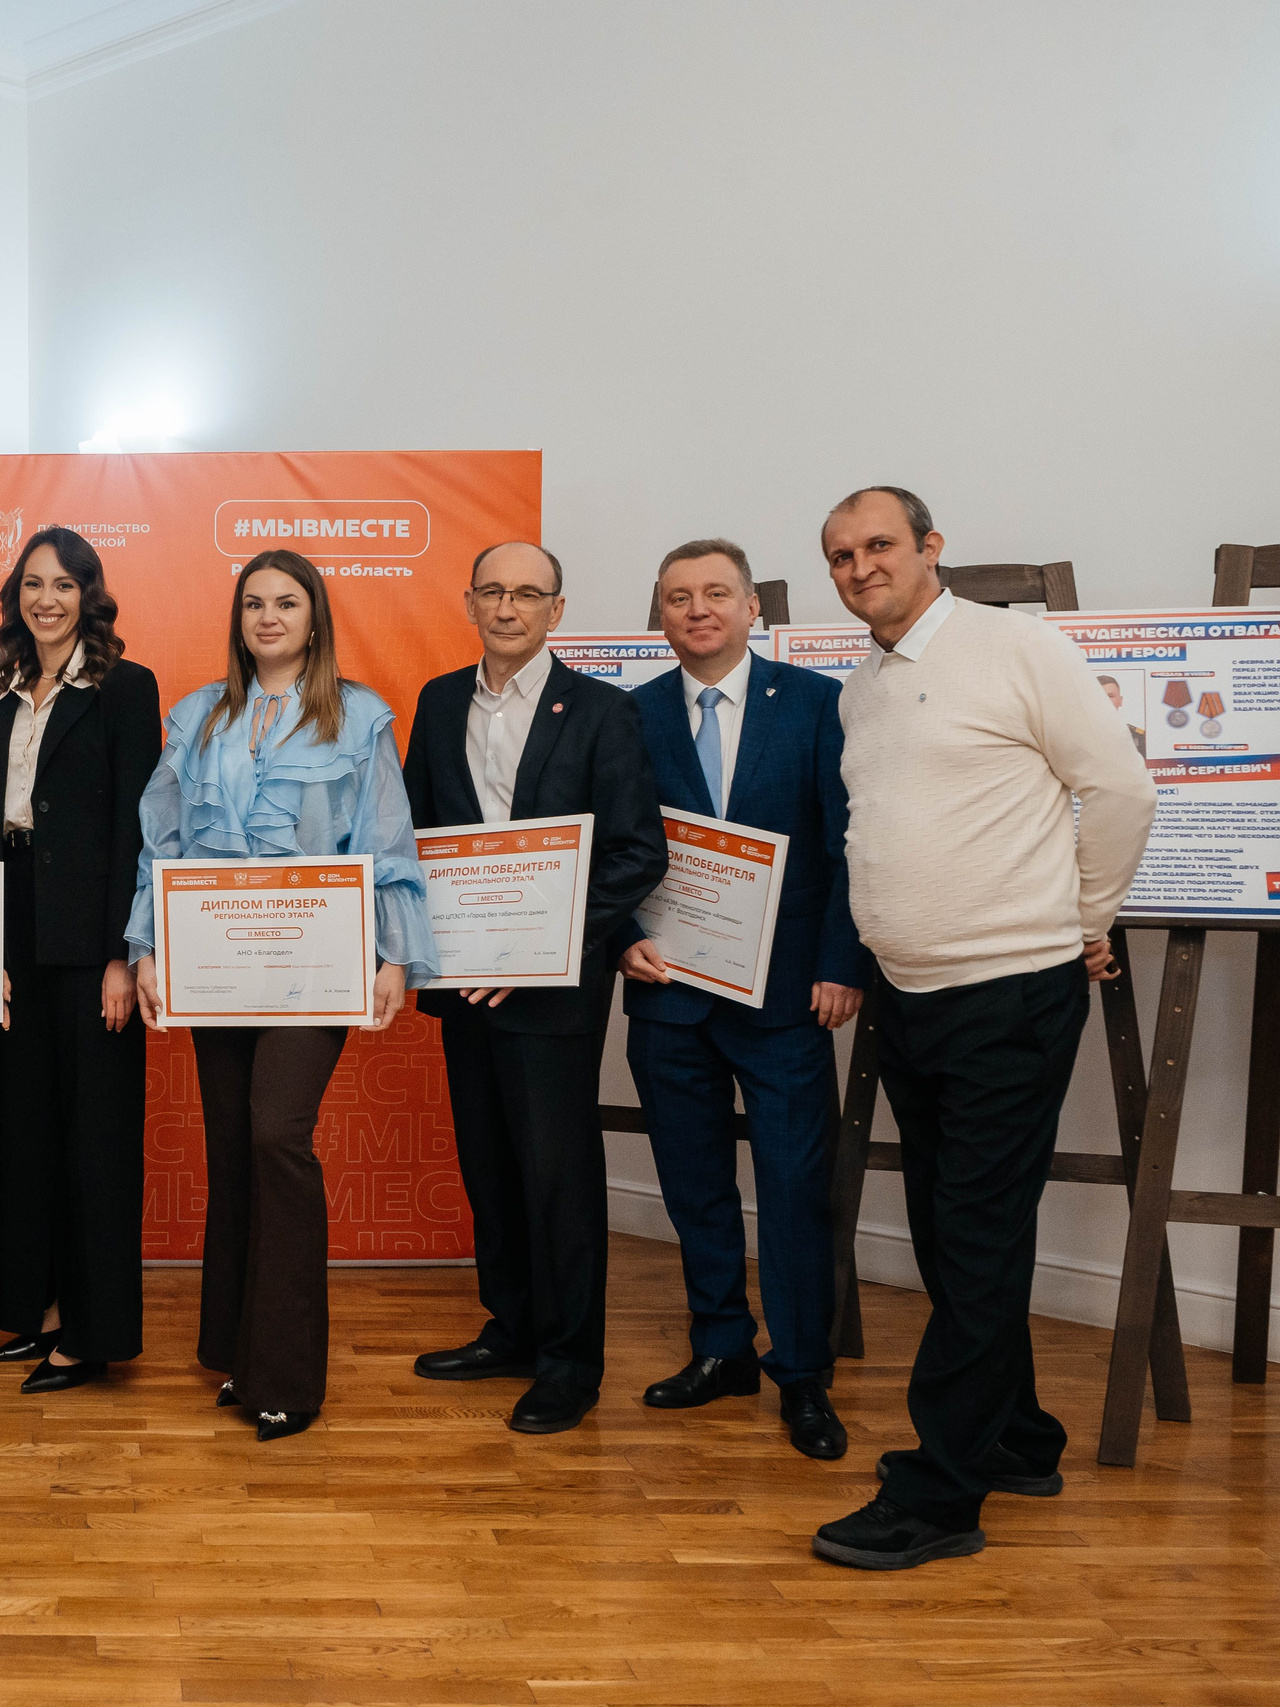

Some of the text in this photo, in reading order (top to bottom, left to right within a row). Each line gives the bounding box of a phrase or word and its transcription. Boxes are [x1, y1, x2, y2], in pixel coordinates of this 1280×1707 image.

[233, 518, 411, 538] #МЫВМЕСТЕ
[339, 562, 413, 577] область
[1121, 646, 1180, 659] ГЕРОИ
[793, 656, 838, 667] НАШИ
[1188, 763, 1271, 776] СЕРГЕЕВИЧ
[429, 860, 561, 880] ДИПЛОМ ПОБЕДИТЕЛЯ
[685, 855, 756, 883] ПОБЕДИТЕЛЯ
[450, 875, 535, 886] РЕГИОНАЛЬНОГО ЭТАПА
[711, 875, 731, 886] ЭТАПА
[682, 885, 702, 896] МЕСТО
[200, 898, 328, 912] ДИПЛОМ ПРИЗЕРА
[214, 911, 314, 920] РЕГИОНАЛЬНОГО ЭТАПА
[254, 930, 281, 938] МЕСТО
